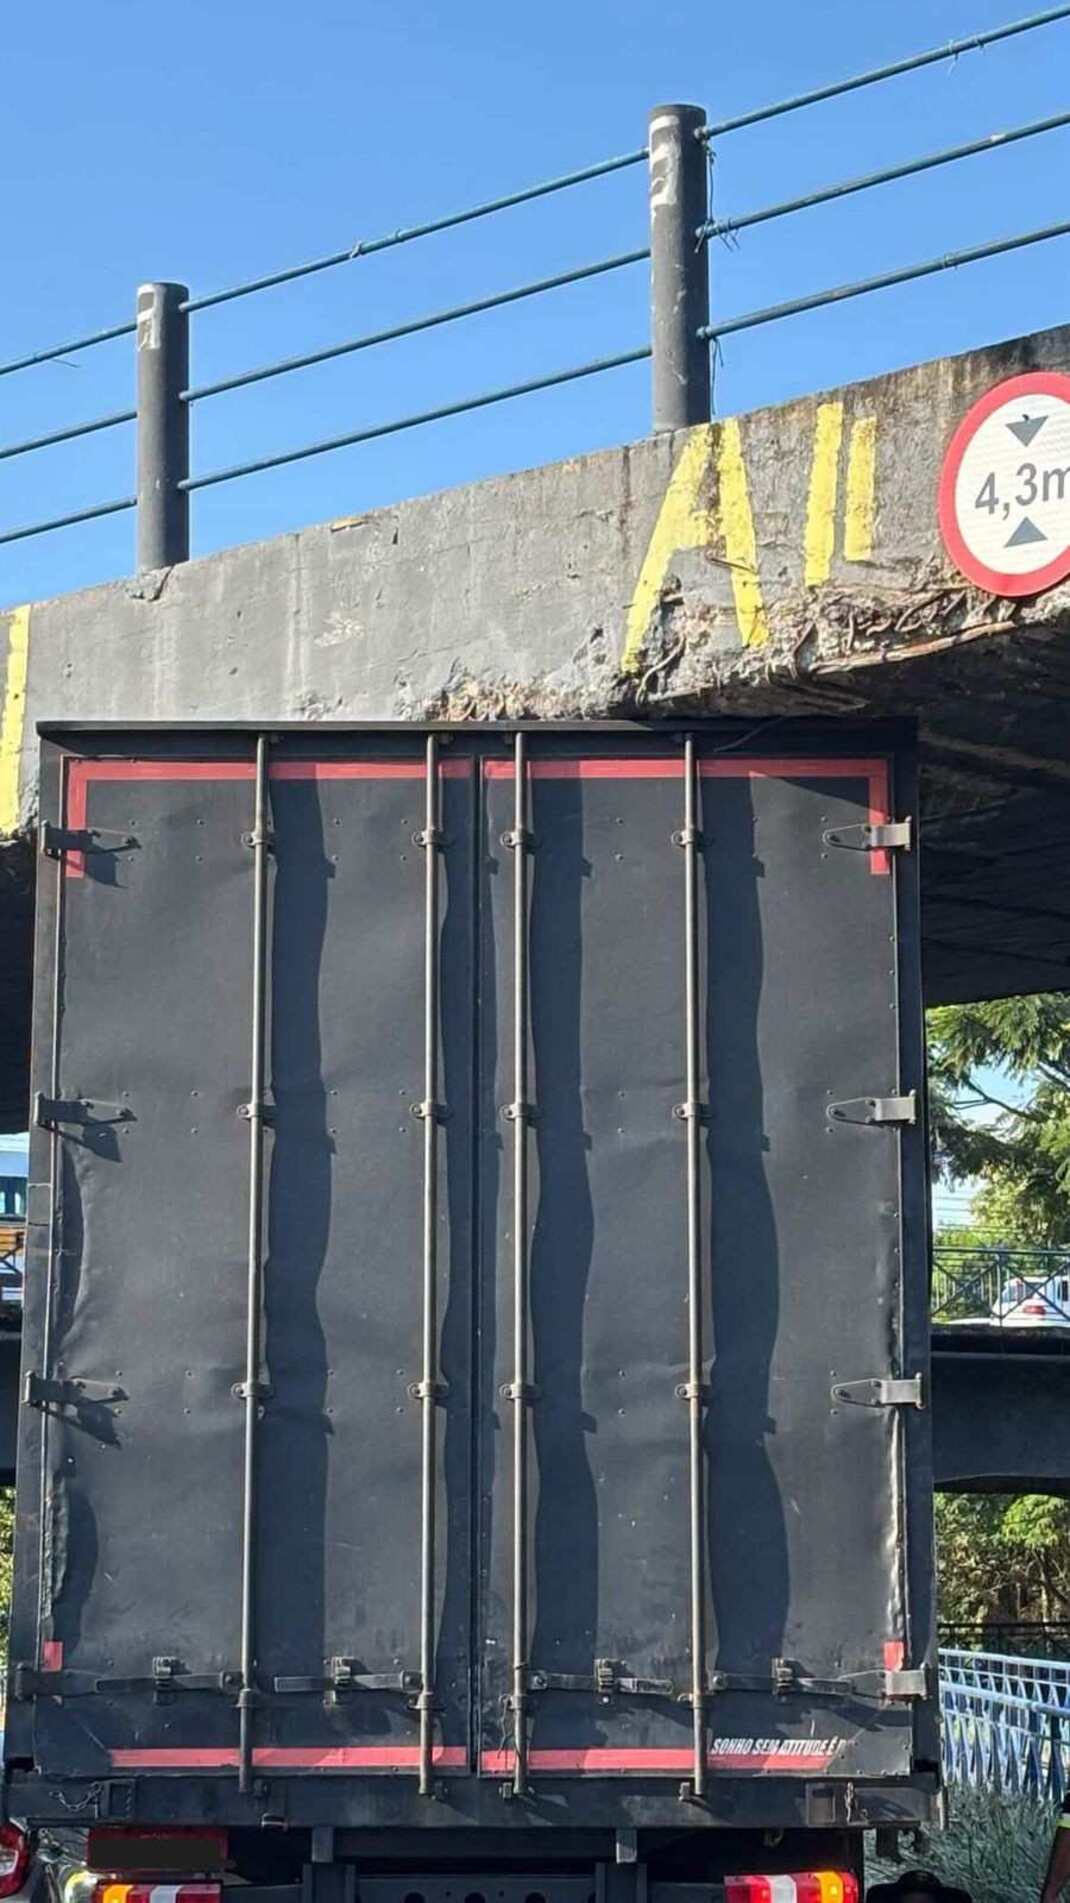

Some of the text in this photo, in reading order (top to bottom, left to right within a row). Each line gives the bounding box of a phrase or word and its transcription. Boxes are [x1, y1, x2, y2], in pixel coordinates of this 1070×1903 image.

[711, 1738, 754, 1755] SONHO
[752, 1738, 780, 1756] SEM
[777, 1739, 829, 1756] ATITUDE
